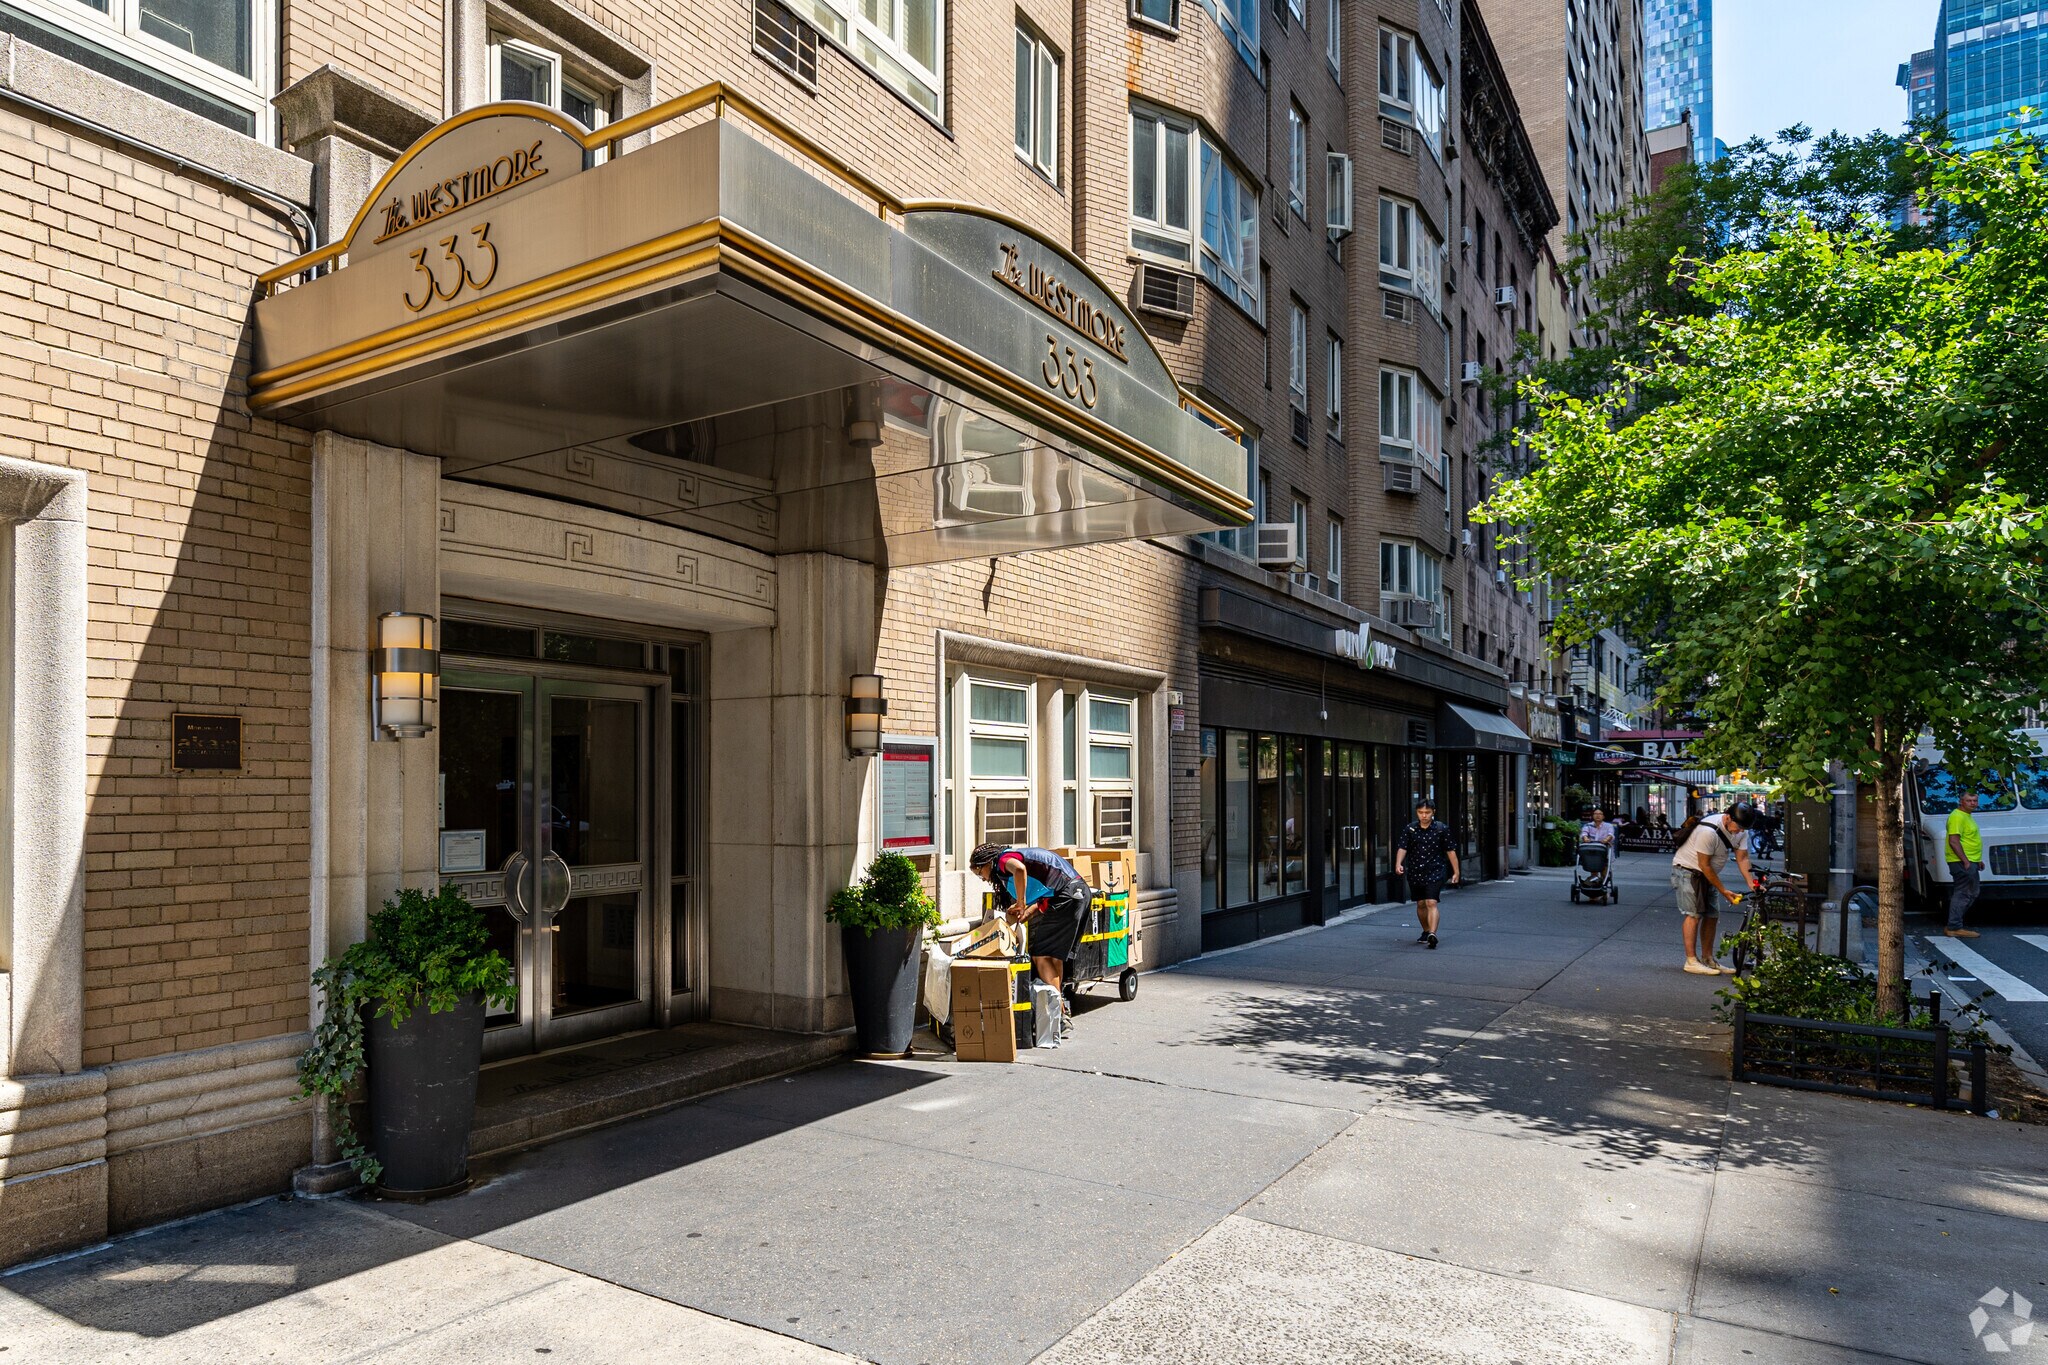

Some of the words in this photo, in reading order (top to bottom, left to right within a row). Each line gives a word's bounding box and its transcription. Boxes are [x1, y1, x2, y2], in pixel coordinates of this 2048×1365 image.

[379, 197, 410, 237] The
[411, 140, 546, 222] WESTMORE
[402, 222, 498, 312] 333
[997, 242, 1025, 287] The
[1029, 262, 1126, 355] WESTMORE
[1042, 334, 1098, 408] 333
[1640, 828, 1674, 840] ABA
